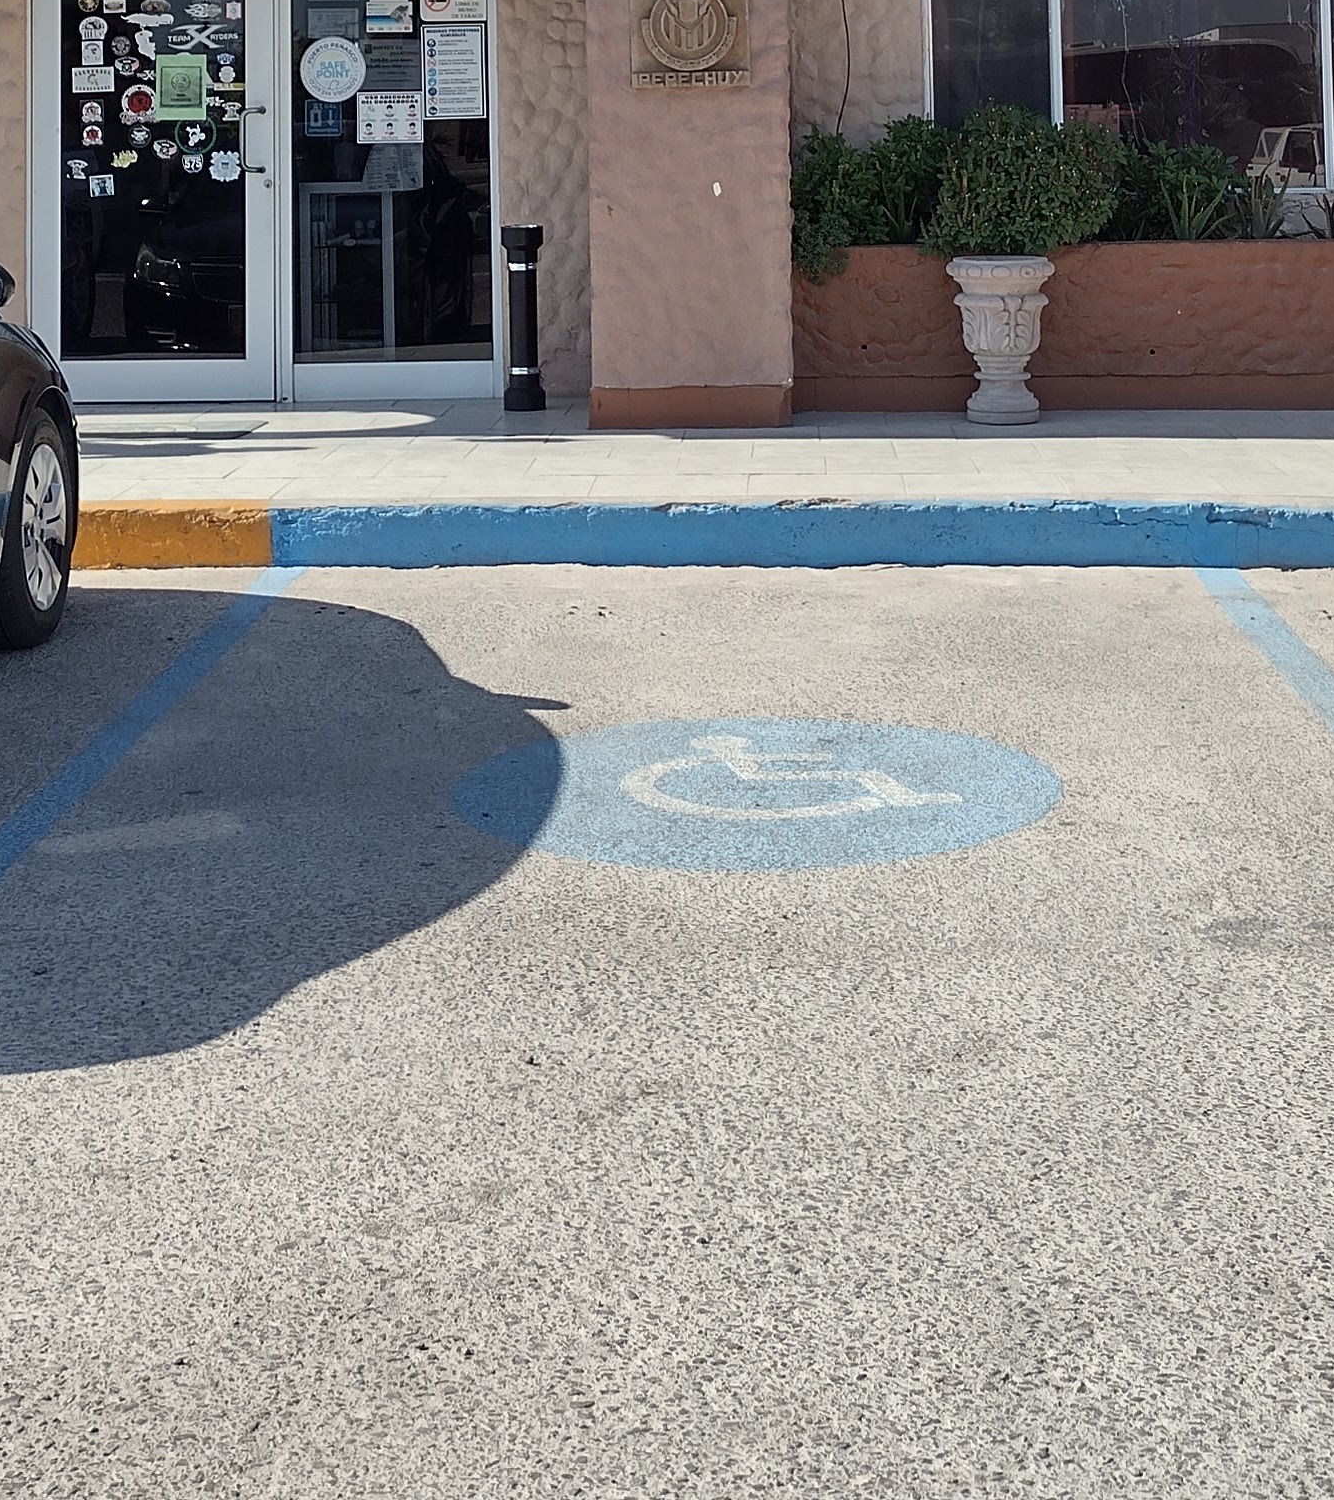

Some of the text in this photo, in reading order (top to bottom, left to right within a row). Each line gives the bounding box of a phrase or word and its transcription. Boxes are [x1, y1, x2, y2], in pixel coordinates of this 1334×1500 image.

[168, 35, 192, 43] TEAM
[307, 43, 329, 65] PUERTO
[320, 60, 347, 70] SAFE
[317, 69, 351, 78] POINT
